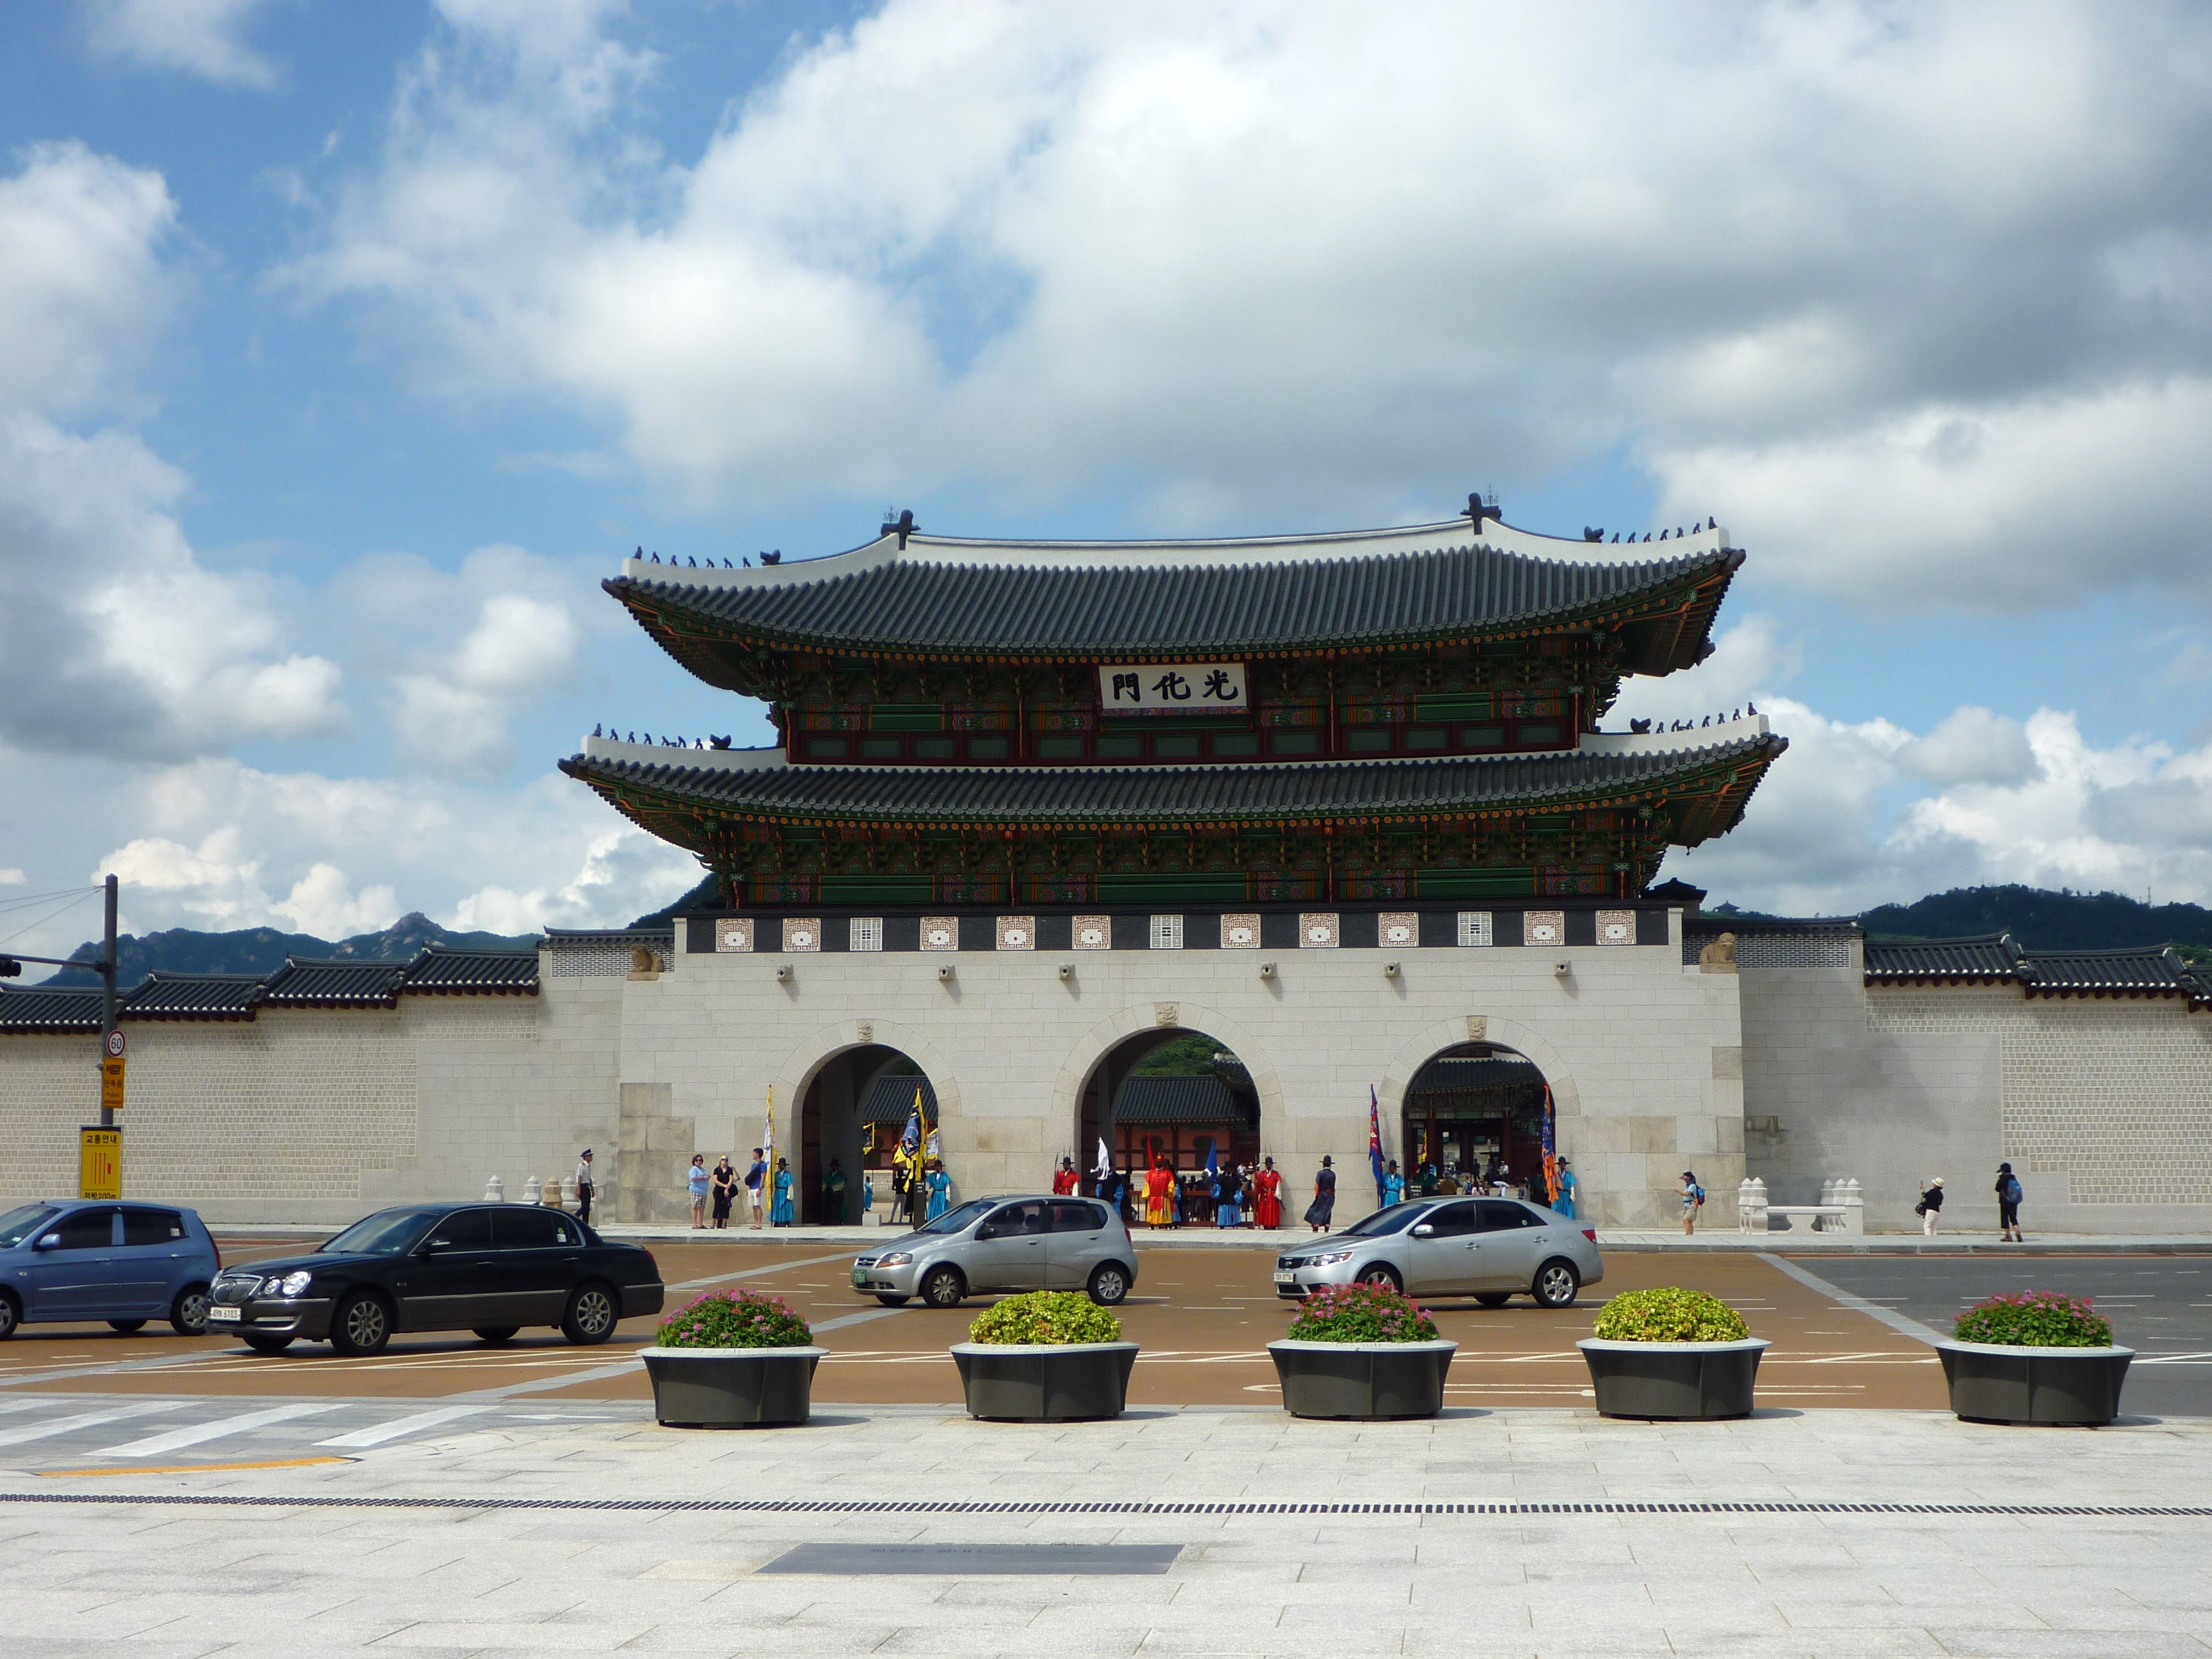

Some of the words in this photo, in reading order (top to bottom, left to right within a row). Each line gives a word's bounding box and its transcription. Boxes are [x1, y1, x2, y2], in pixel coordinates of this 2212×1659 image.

[111, 1038, 122, 1049] 60
[86, 1134, 117, 1144] 교통안내
[224, 1310, 237, 1318] 6103
